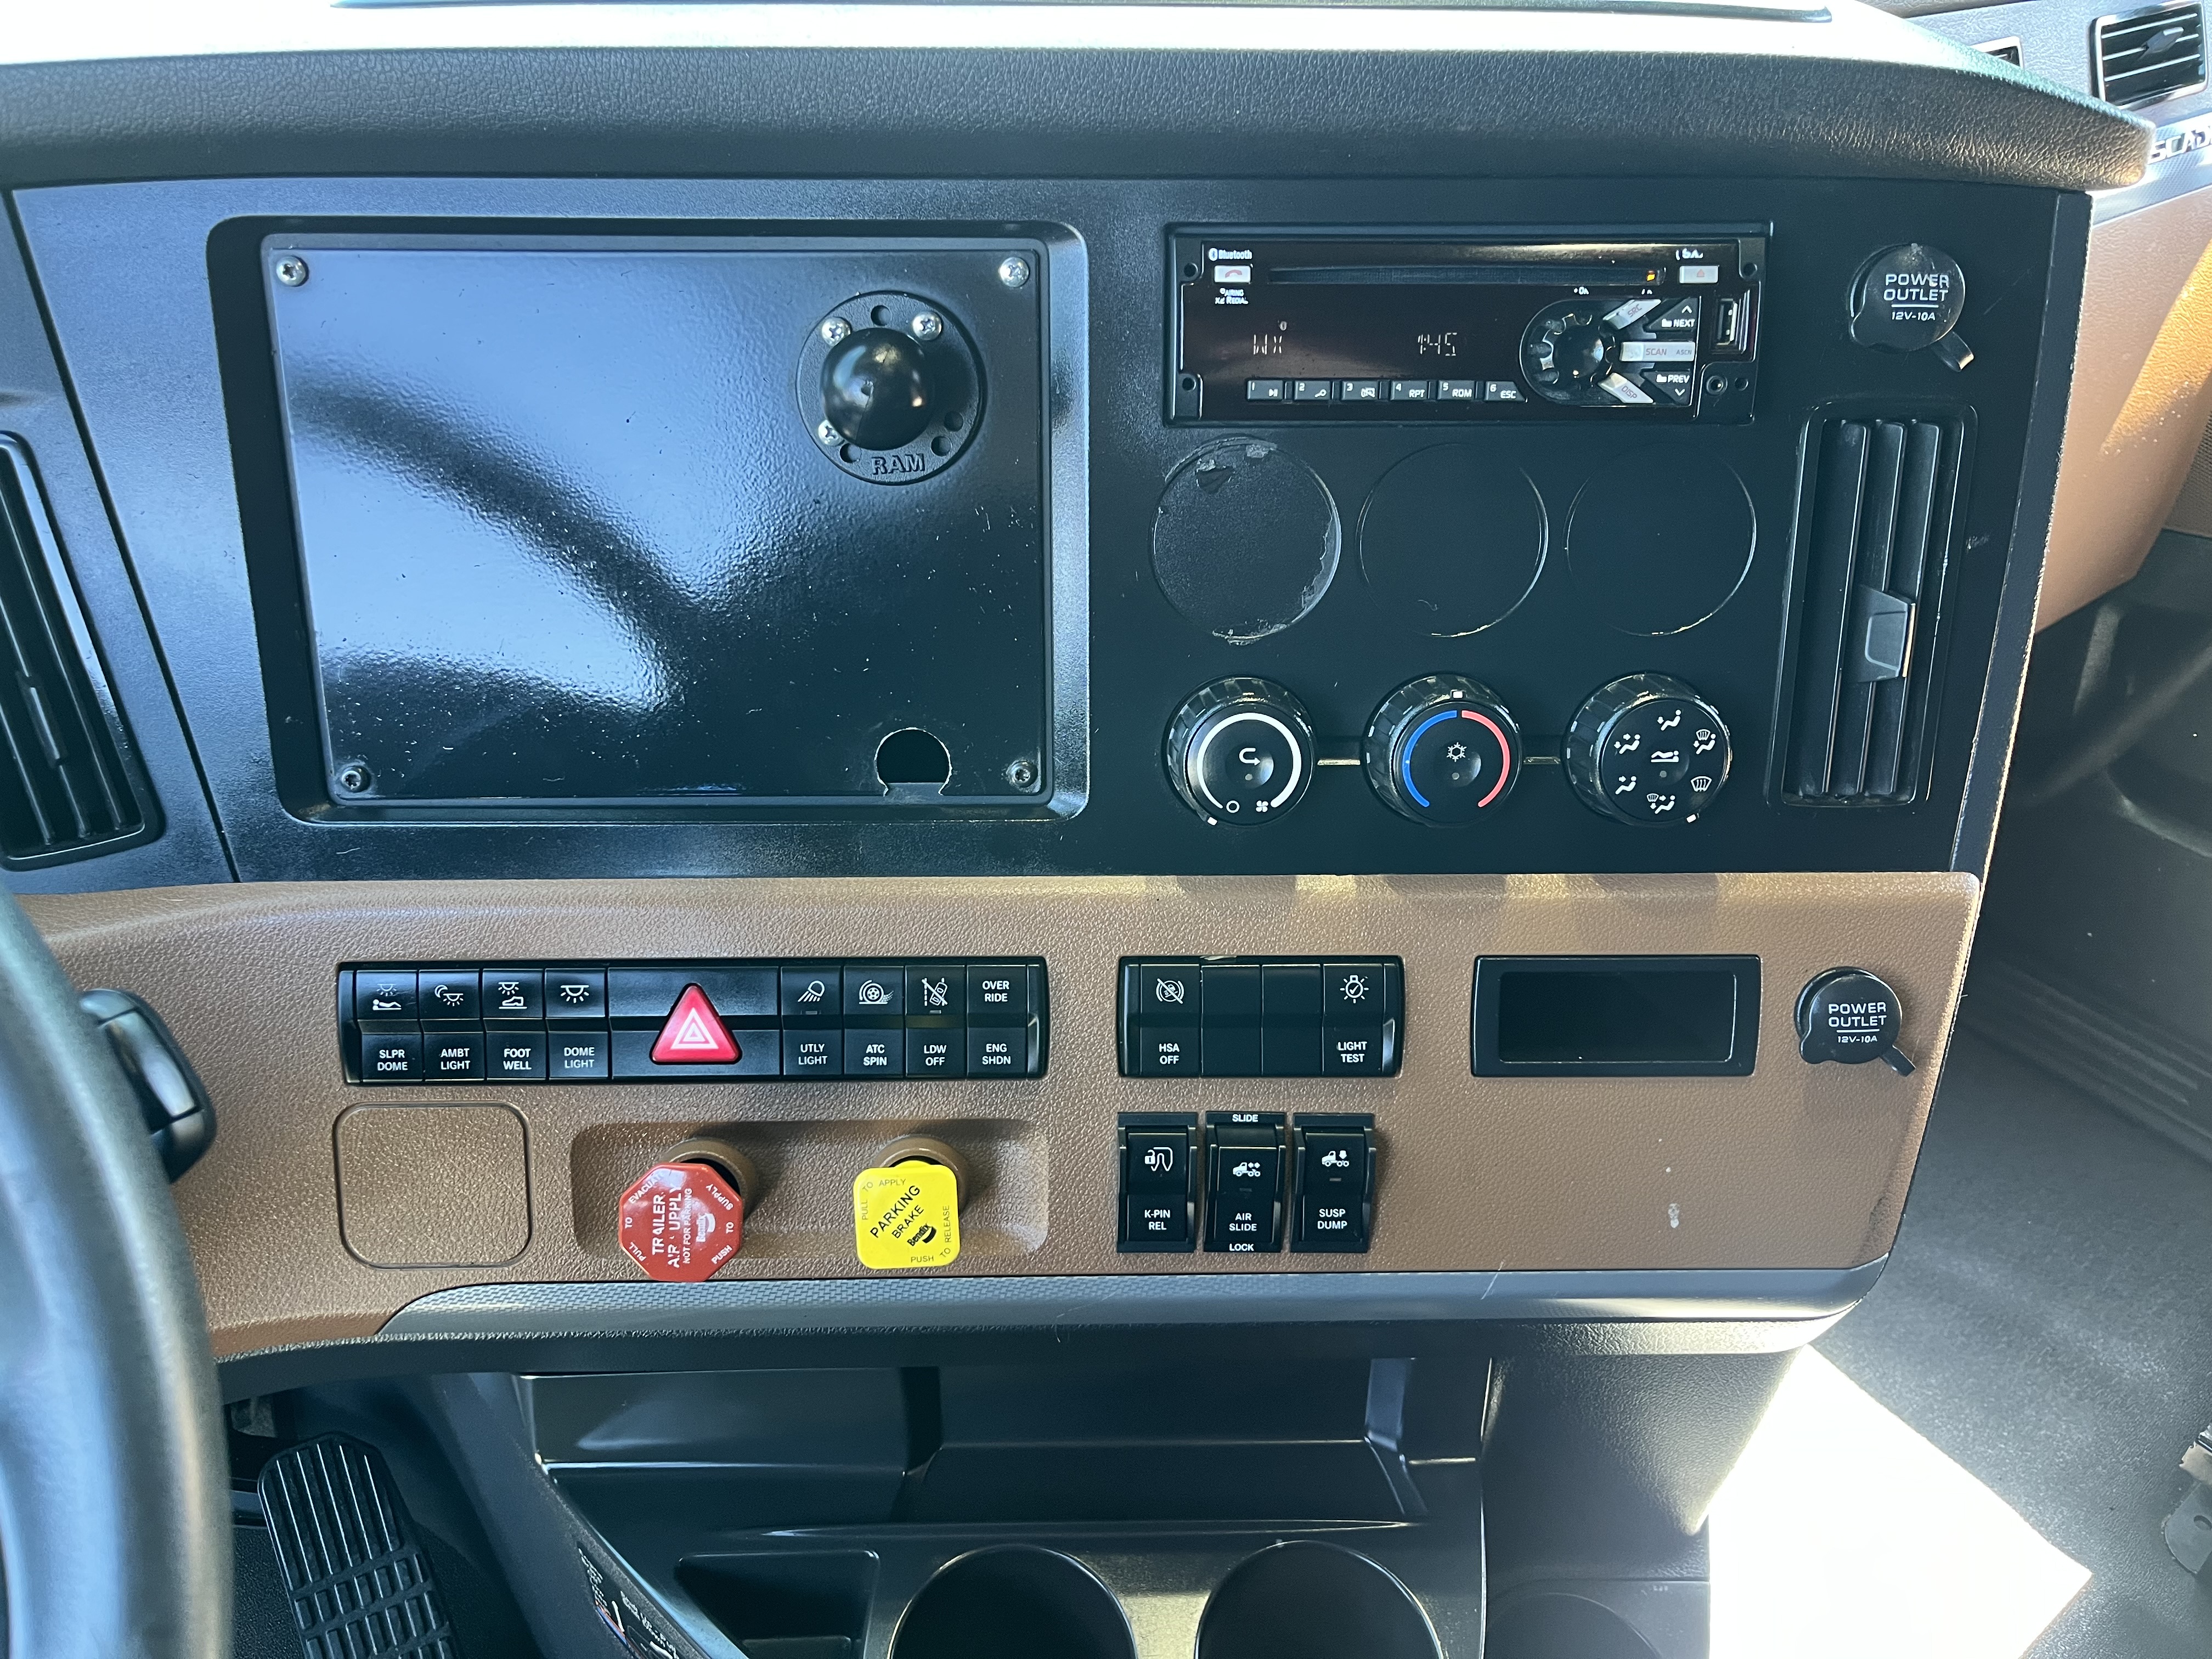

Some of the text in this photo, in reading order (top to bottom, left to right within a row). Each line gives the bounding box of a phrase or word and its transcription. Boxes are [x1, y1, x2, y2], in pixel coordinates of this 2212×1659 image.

[1218, 249, 1252, 259] Bluetooth
[1885, 273, 1949, 288] POWER
[1883, 289, 1949, 302] OUTLET
[1627, 303, 1643, 318] SRC
[1892, 312, 1936, 321] 12V-10A
[1673, 319, 1696, 328] NEXT
[1418, 332, 1457, 356] 1:45
[1667, 374, 1690, 383] PREV
[1251, 382, 1255, 391] 1
[1299, 382, 1305, 391] 2
[1347, 382, 1353, 391] 3
[1395, 383, 1425, 398] 4 RPT
[1443, 382, 1472, 397] 5 RDM
[1489, 383, 1517, 399] 6 ESC
[1621, 385, 1638, 399] DISP
[871, 453, 926, 475] RAM
[982, 980, 1009, 990] OVER
[984, 993, 1008, 1002] RIDE
[1828, 1002, 1887, 1014] POWER
[1828, 1015, 1887, 1028] OUTLET
[800, 1043, 825, 1053] UTLY
[866, 1044, 885, 1054] ATC
[923, 1045, 947, 1054] LDW
[986, 1043, 1007, 1053] ENG
[1159, 1043, 1180, 1052] HSA
[1338, 1041, 1367, 1051] LIGHT
[379, 1048, 405, 1059] SLPR
[441, 1048, 470, 1058] AMBT
[504, 1048, 531, 1058] FOOT
[564, 1047, 595, 1057] DOME
[798, 1056, 827, 1065] LIGHT
[863, 1056, 887, 1066] SPIN
[925, 1056, 945, 1066] OFF
[982, 1056, 1011, 1065] SHDN
[1159, 1056, 1179, 1064] OFF
[1341, 1053, 1364, 1063] TEST
[377, 1062, 408, 1071] DOME
[441, 1060, 470, 1070] LIGHT
[503, 1060, 532, 1070] WELL
[565, 1059, 595, 1068] LIGHT
[1232, 1114, 1259, 1122] SLIDE
[862, 1181, 873, 1192] TO
[878, 1178, 906, 1187] APPLY
[869, 1185, 921, 1239] PARKING
[1144, 1209, 1171, 1218] K-PIN
[1235, 1212, 1252, 1221] AIR
[1319, 1209, 1346, 1217] SUSP
[625, 1217, 633, 1229] TO
[652, 1194, 665, 1255] TRAILER
[683, 1188, 692, 1264] NOT FOR PARKING
[706, 1183, 735, 1265] PUSH TO SUPPLY
[891, 1204, 925, 1239] BRAKE
[943, 1205, 951, 1243] RELEASE
[1148, 1221, 1167, 1231] REL
[1317, 1221, 1347, 1230] DUMP
[1229, 1223, 1257, 1232] SLIDE
[907, 1222, 933, 1247] Bendix
[629, 1242, 647, 1262] PULL
[1229, 1243, 1255, 1251] LOCK
[939, 1247, 951, 1258] TO
